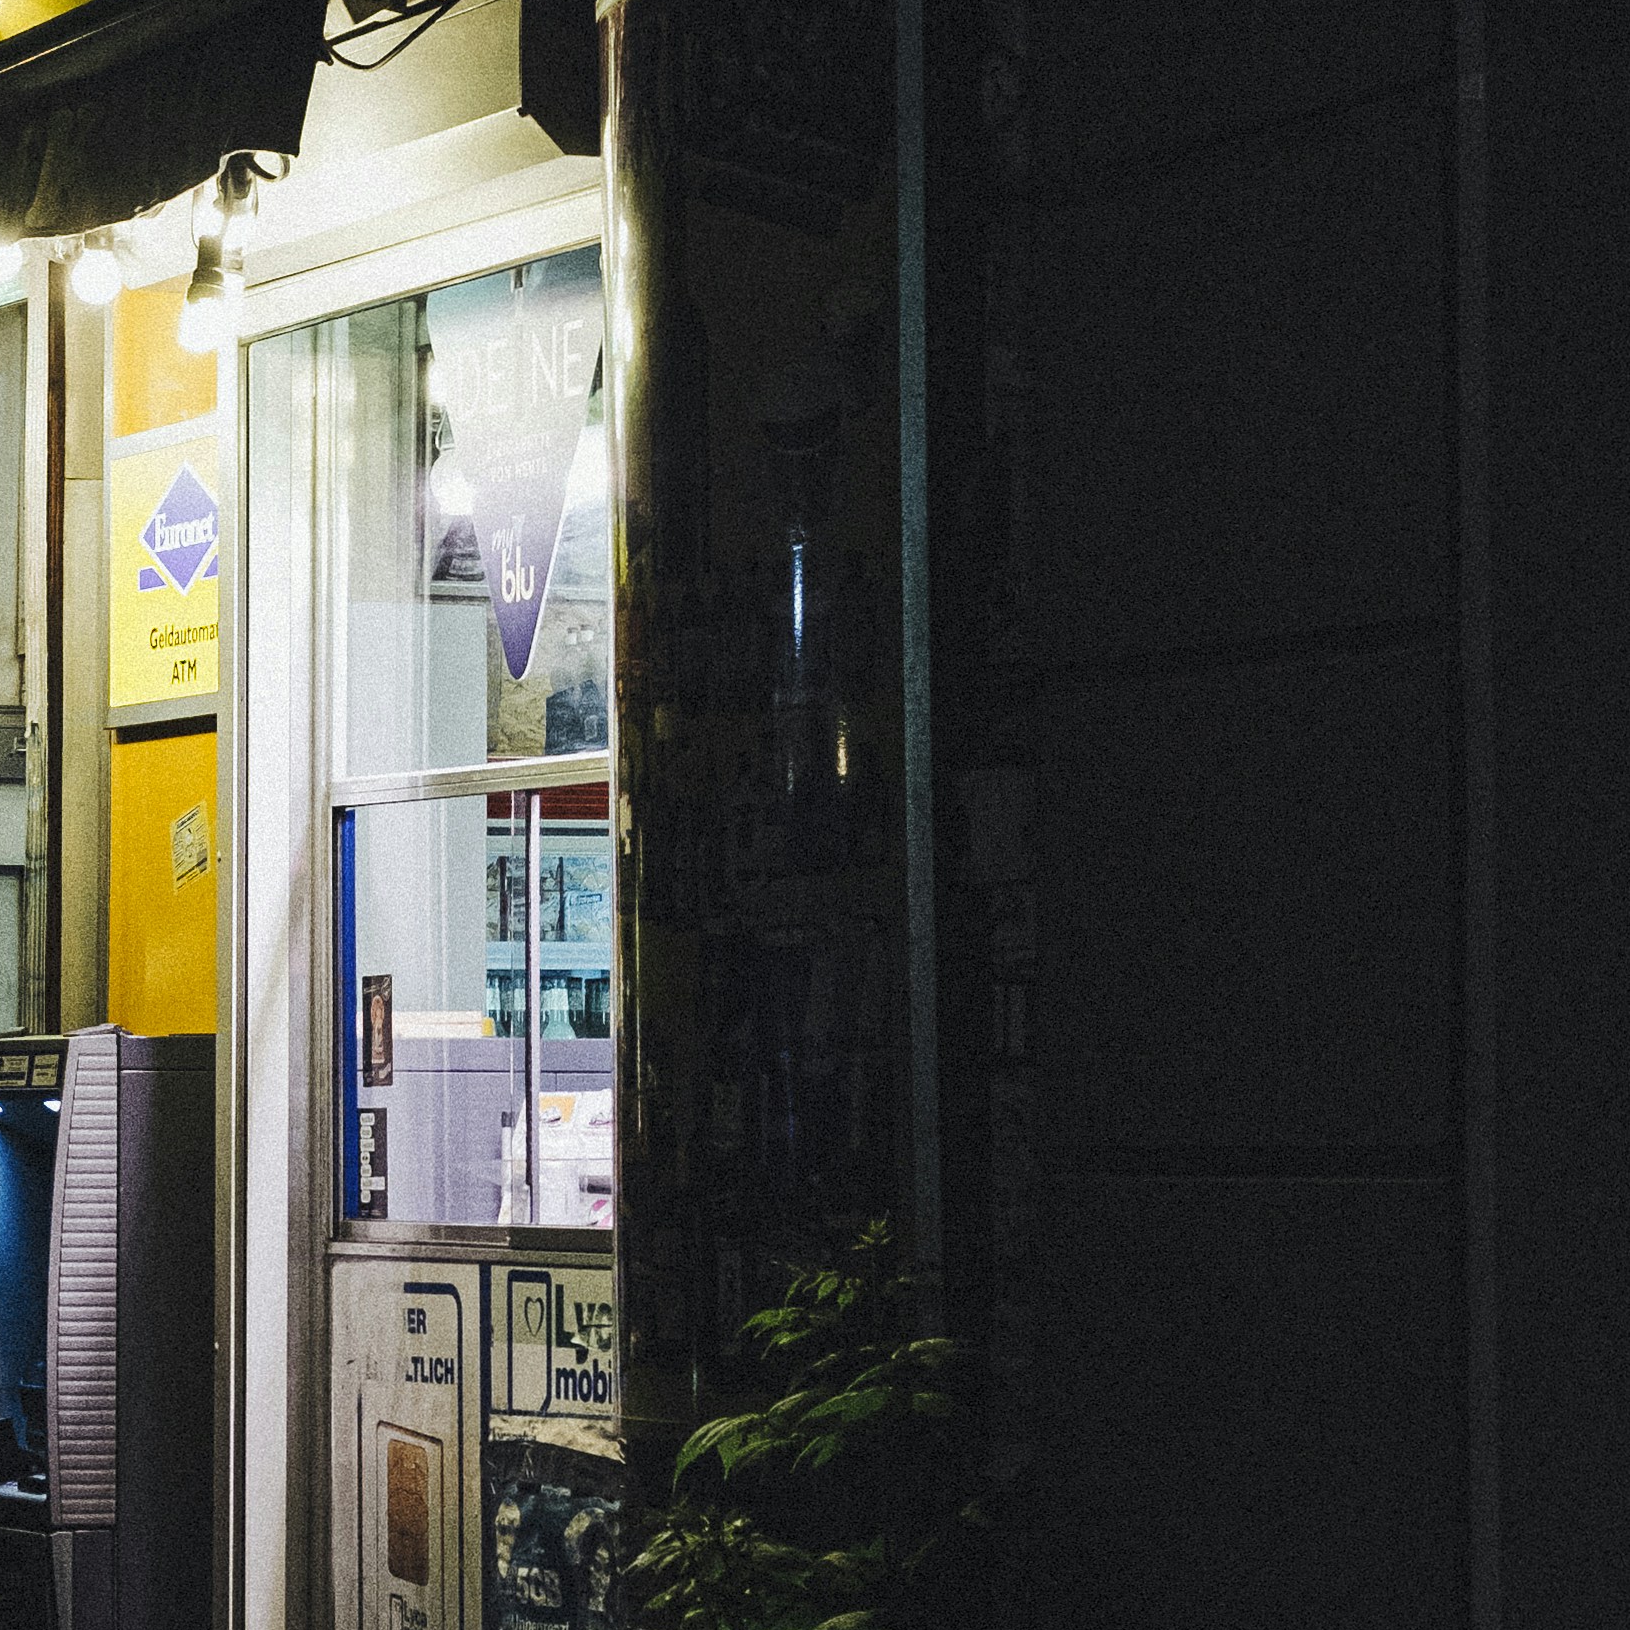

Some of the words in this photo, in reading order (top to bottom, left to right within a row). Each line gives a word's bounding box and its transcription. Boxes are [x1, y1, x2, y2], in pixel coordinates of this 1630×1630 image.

[153, 512, 216, 553] Euronet
[501, 545, 535, 604] blu
[171, 658, 197, 685] ATM
